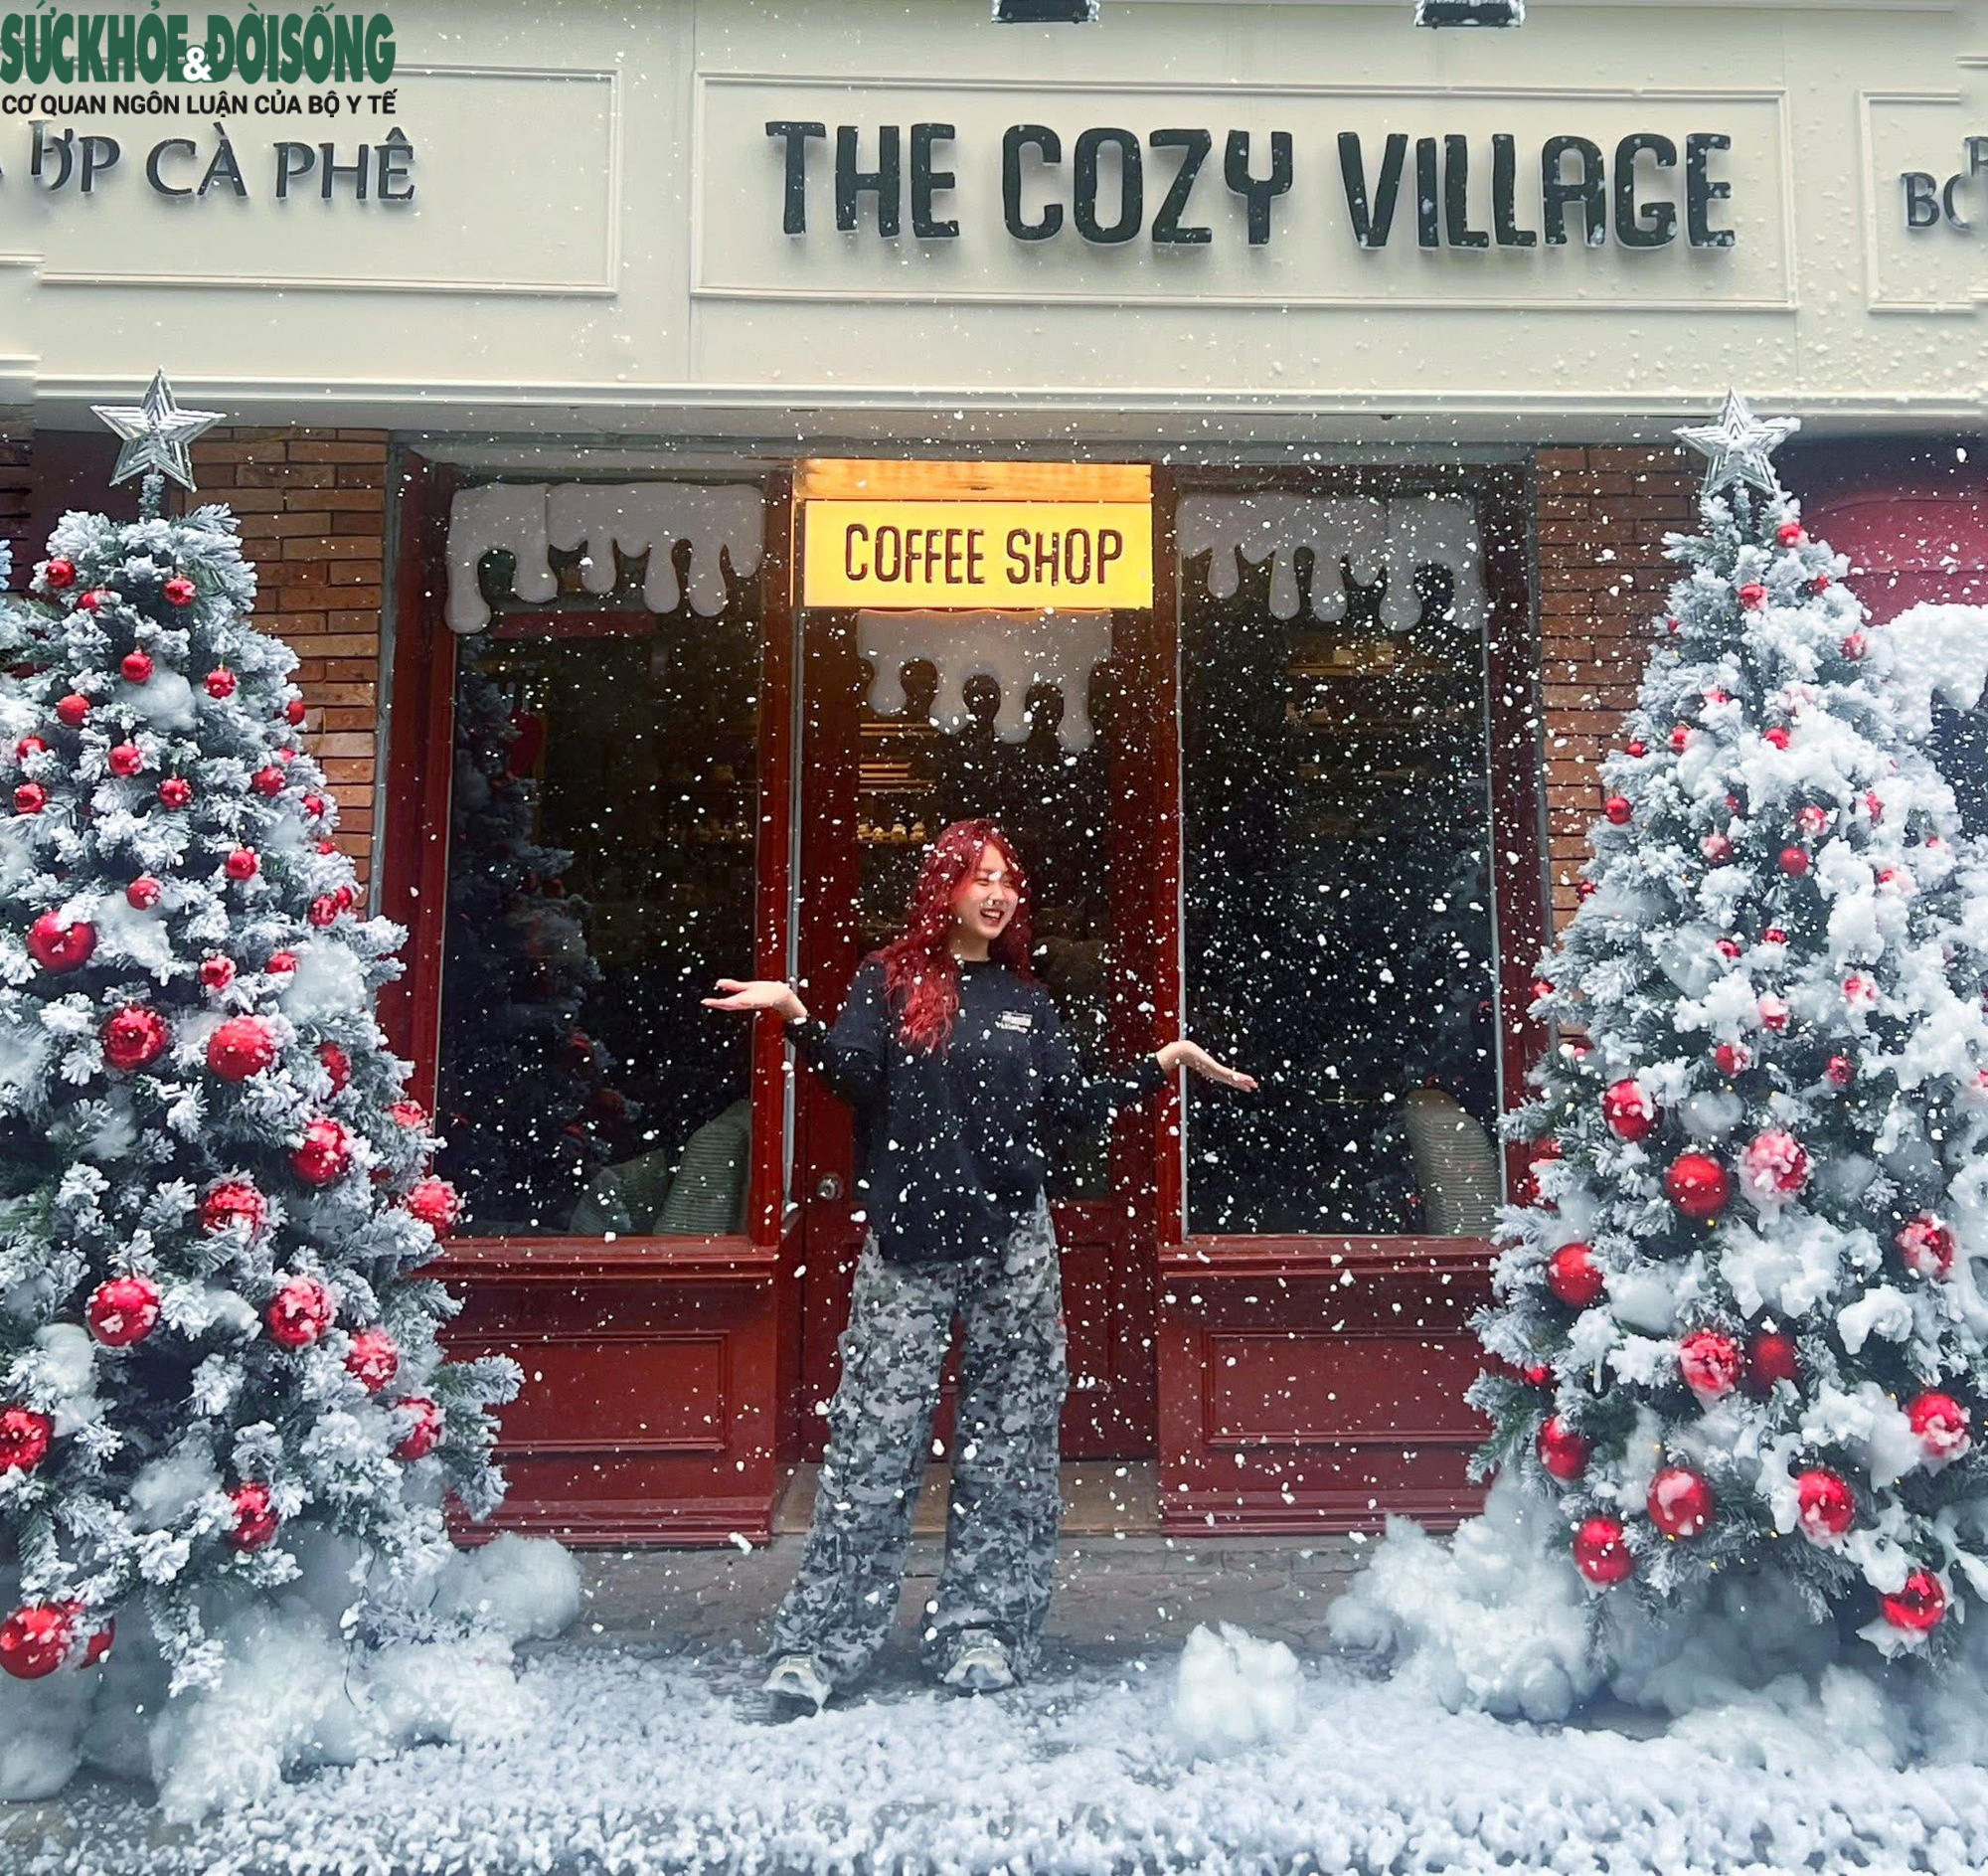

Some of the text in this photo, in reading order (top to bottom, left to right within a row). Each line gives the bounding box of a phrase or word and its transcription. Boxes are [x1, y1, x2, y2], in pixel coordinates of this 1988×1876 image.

[146, 121, 248, 196] CÀ
[273, 126, 414, 199] PHÊ
[765, 121, 1736, 250] THE COZY VILLAGE
[845, 524, 1123, 586] COFFEE SHOP
